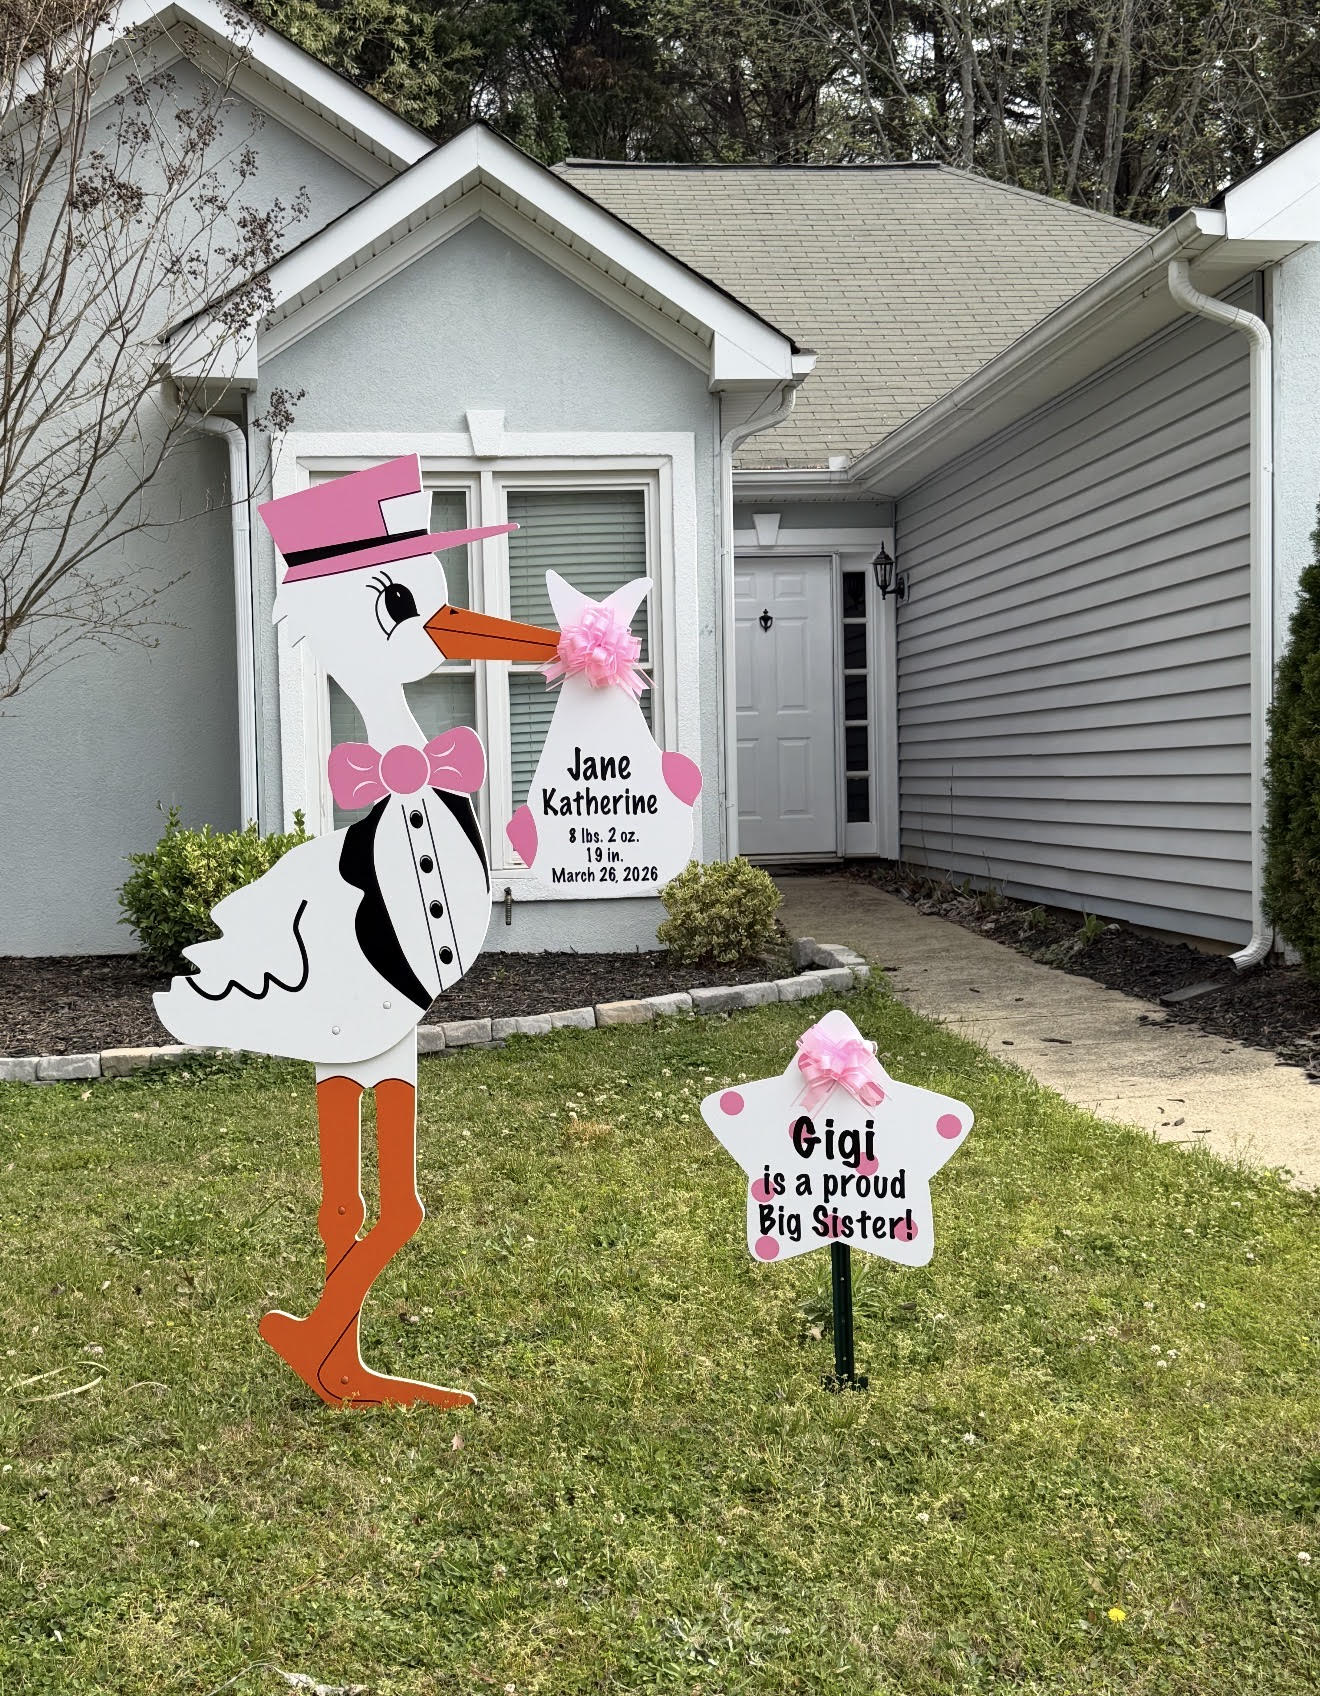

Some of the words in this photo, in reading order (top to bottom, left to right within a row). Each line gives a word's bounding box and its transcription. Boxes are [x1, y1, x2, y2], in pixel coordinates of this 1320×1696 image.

[566, 746, 632, 782] Jane
[542, 786, 658, 817] Katherine
[569, 827, 577, 844] 8
[581, 827, 604, 844] lbs.
[607, 826, 617, 843] 2
[620, 831, 640, 844] oz.
[586, 846, 603, 863] 19
[607, 847, 625, 863] in.
[551, 867, 595, 884] March
[599, 866, 620, 884] 26,
[622, 866, 658, 883] 2026
[792, 1115, 876, 1169] Gigi
[763, 1164, 786, 1196] is
[795, 1173, 813, 1197] a
[823, 1168, 906, 1204] proud
[758, 1203, 802, 1243] Big
[811, 1204, 913, 1242] Sister!
